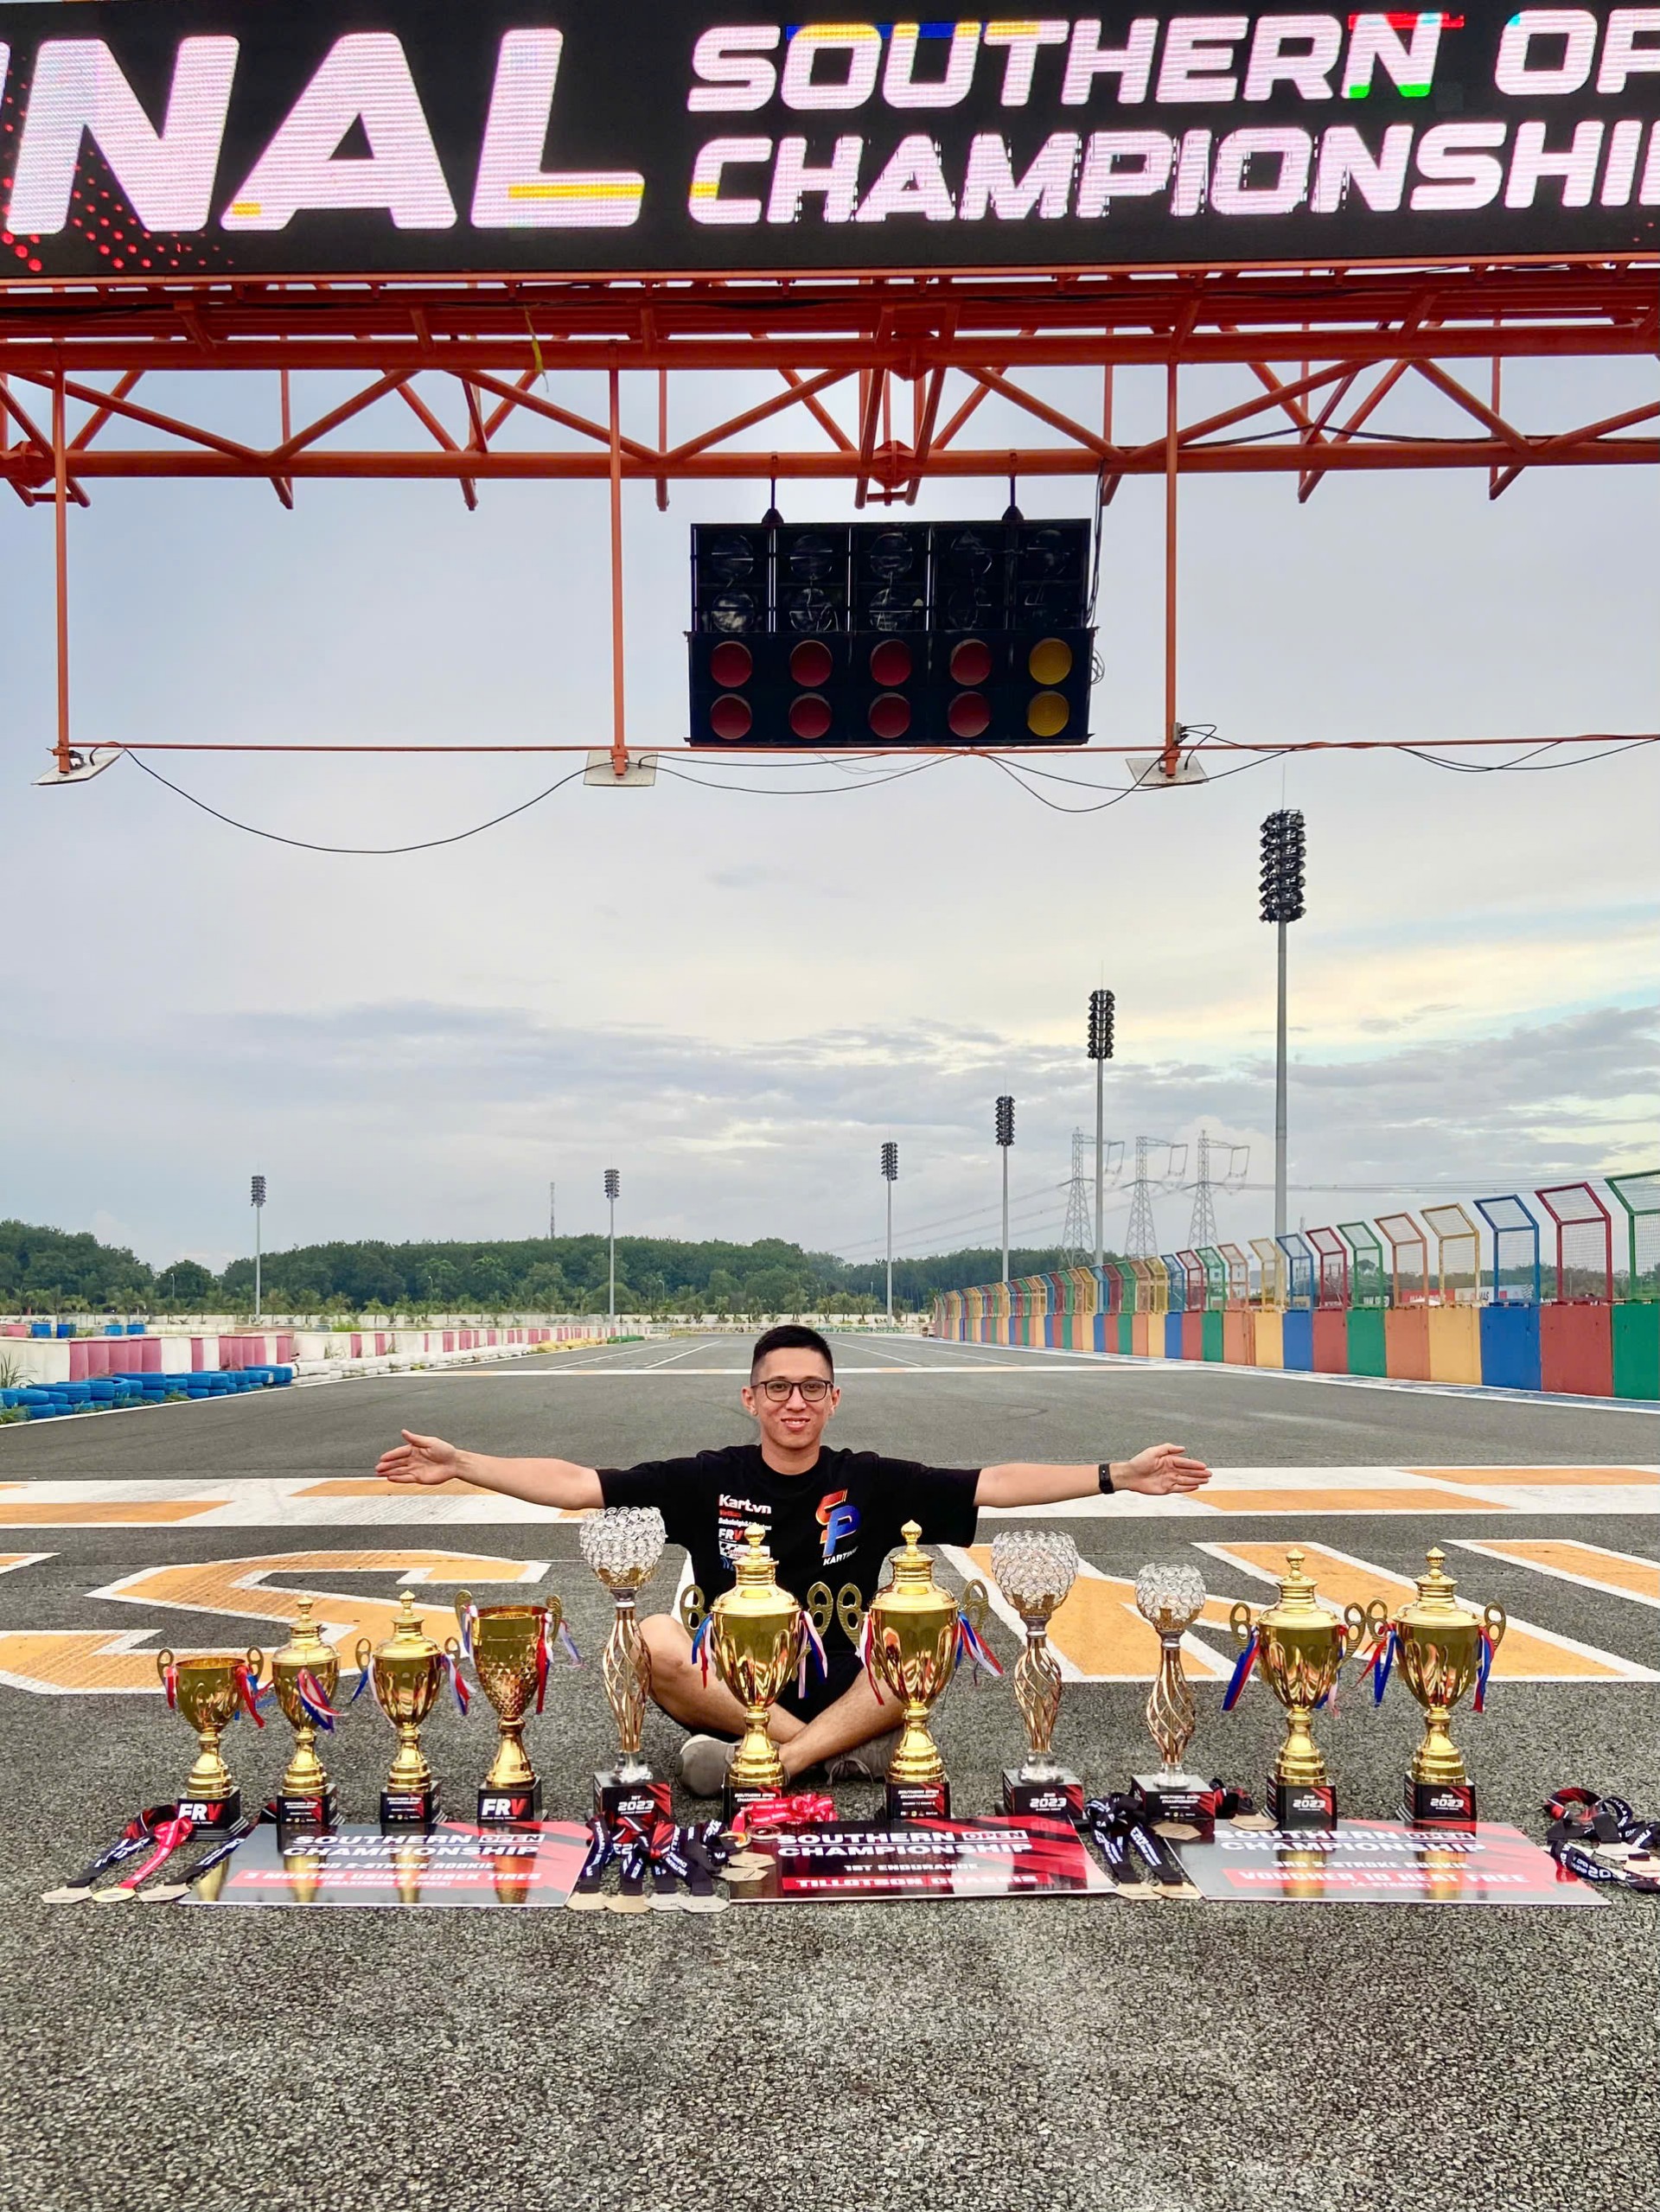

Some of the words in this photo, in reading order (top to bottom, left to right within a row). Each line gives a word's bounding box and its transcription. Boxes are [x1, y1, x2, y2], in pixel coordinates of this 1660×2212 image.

[687, 13, 1441, 111] SOUTHERN
[0, 29, 645, 234] NAL
[718, 1528, 744, 1540] FRV
[482, 1798, 527, 1816] FRV
[617, 1800, 654, 1812] 2023
[1029, 1798, 1067, 1808] 2023
[1293, 1799, 1326, 1808] 2023
[1430, 1798, 1464, 1807] 2023
[178, 1803, 222, 1821] FRV
[292, 1834, 472, 1845] SOUTHERN
[777, 1832, 955, 1844] SOUTHERN
[1213, 1830, 1397, 1840] SOUTHERN
[284, 1845, 539, 1856] CHAMPIONSHIP
[777, 1844, 1032, 1856] CHAMPIONSHIP
[1221, 1841, 1486, 1852] CHAMPIONSHIP
[878, 1863, 979, 1871] ENDURANCE
[796, 1877, 923, 1888] TILLOTSON
[930, 1875, 1038, 1885] CHASSIS
[1238, 1871, 1357, 1881] VOUCHER
[1363, 1872, 1392, 1882] 10
[1396, 1873, 1459, 1883] HEAT
[1465, 1874, 1531, 1883] FREE
